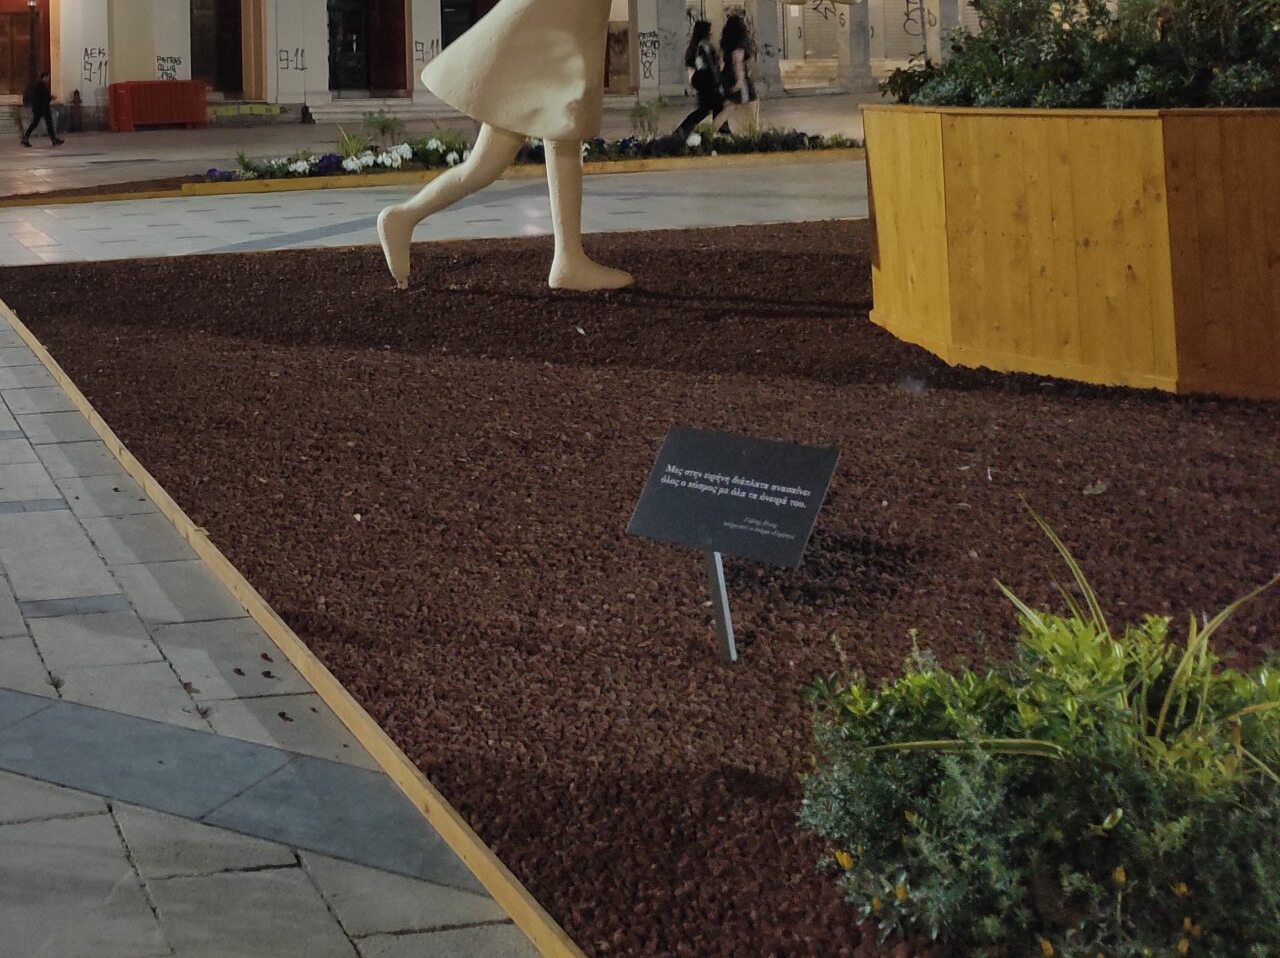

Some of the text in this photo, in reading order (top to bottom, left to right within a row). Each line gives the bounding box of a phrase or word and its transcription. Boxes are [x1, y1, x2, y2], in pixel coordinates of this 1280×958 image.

[665, 464, 684, 476] Μες
[684, 469, 702, 480] στην
[703, 472, 730, 485] ειρήνη
[660, 475, 680, 488] όλος
[687, 480, 718, 494] κόσμος
[718, 486, 729, 496] με
[730, 487, 746, 498] όλα
[748, 492, 758, 500] τα
